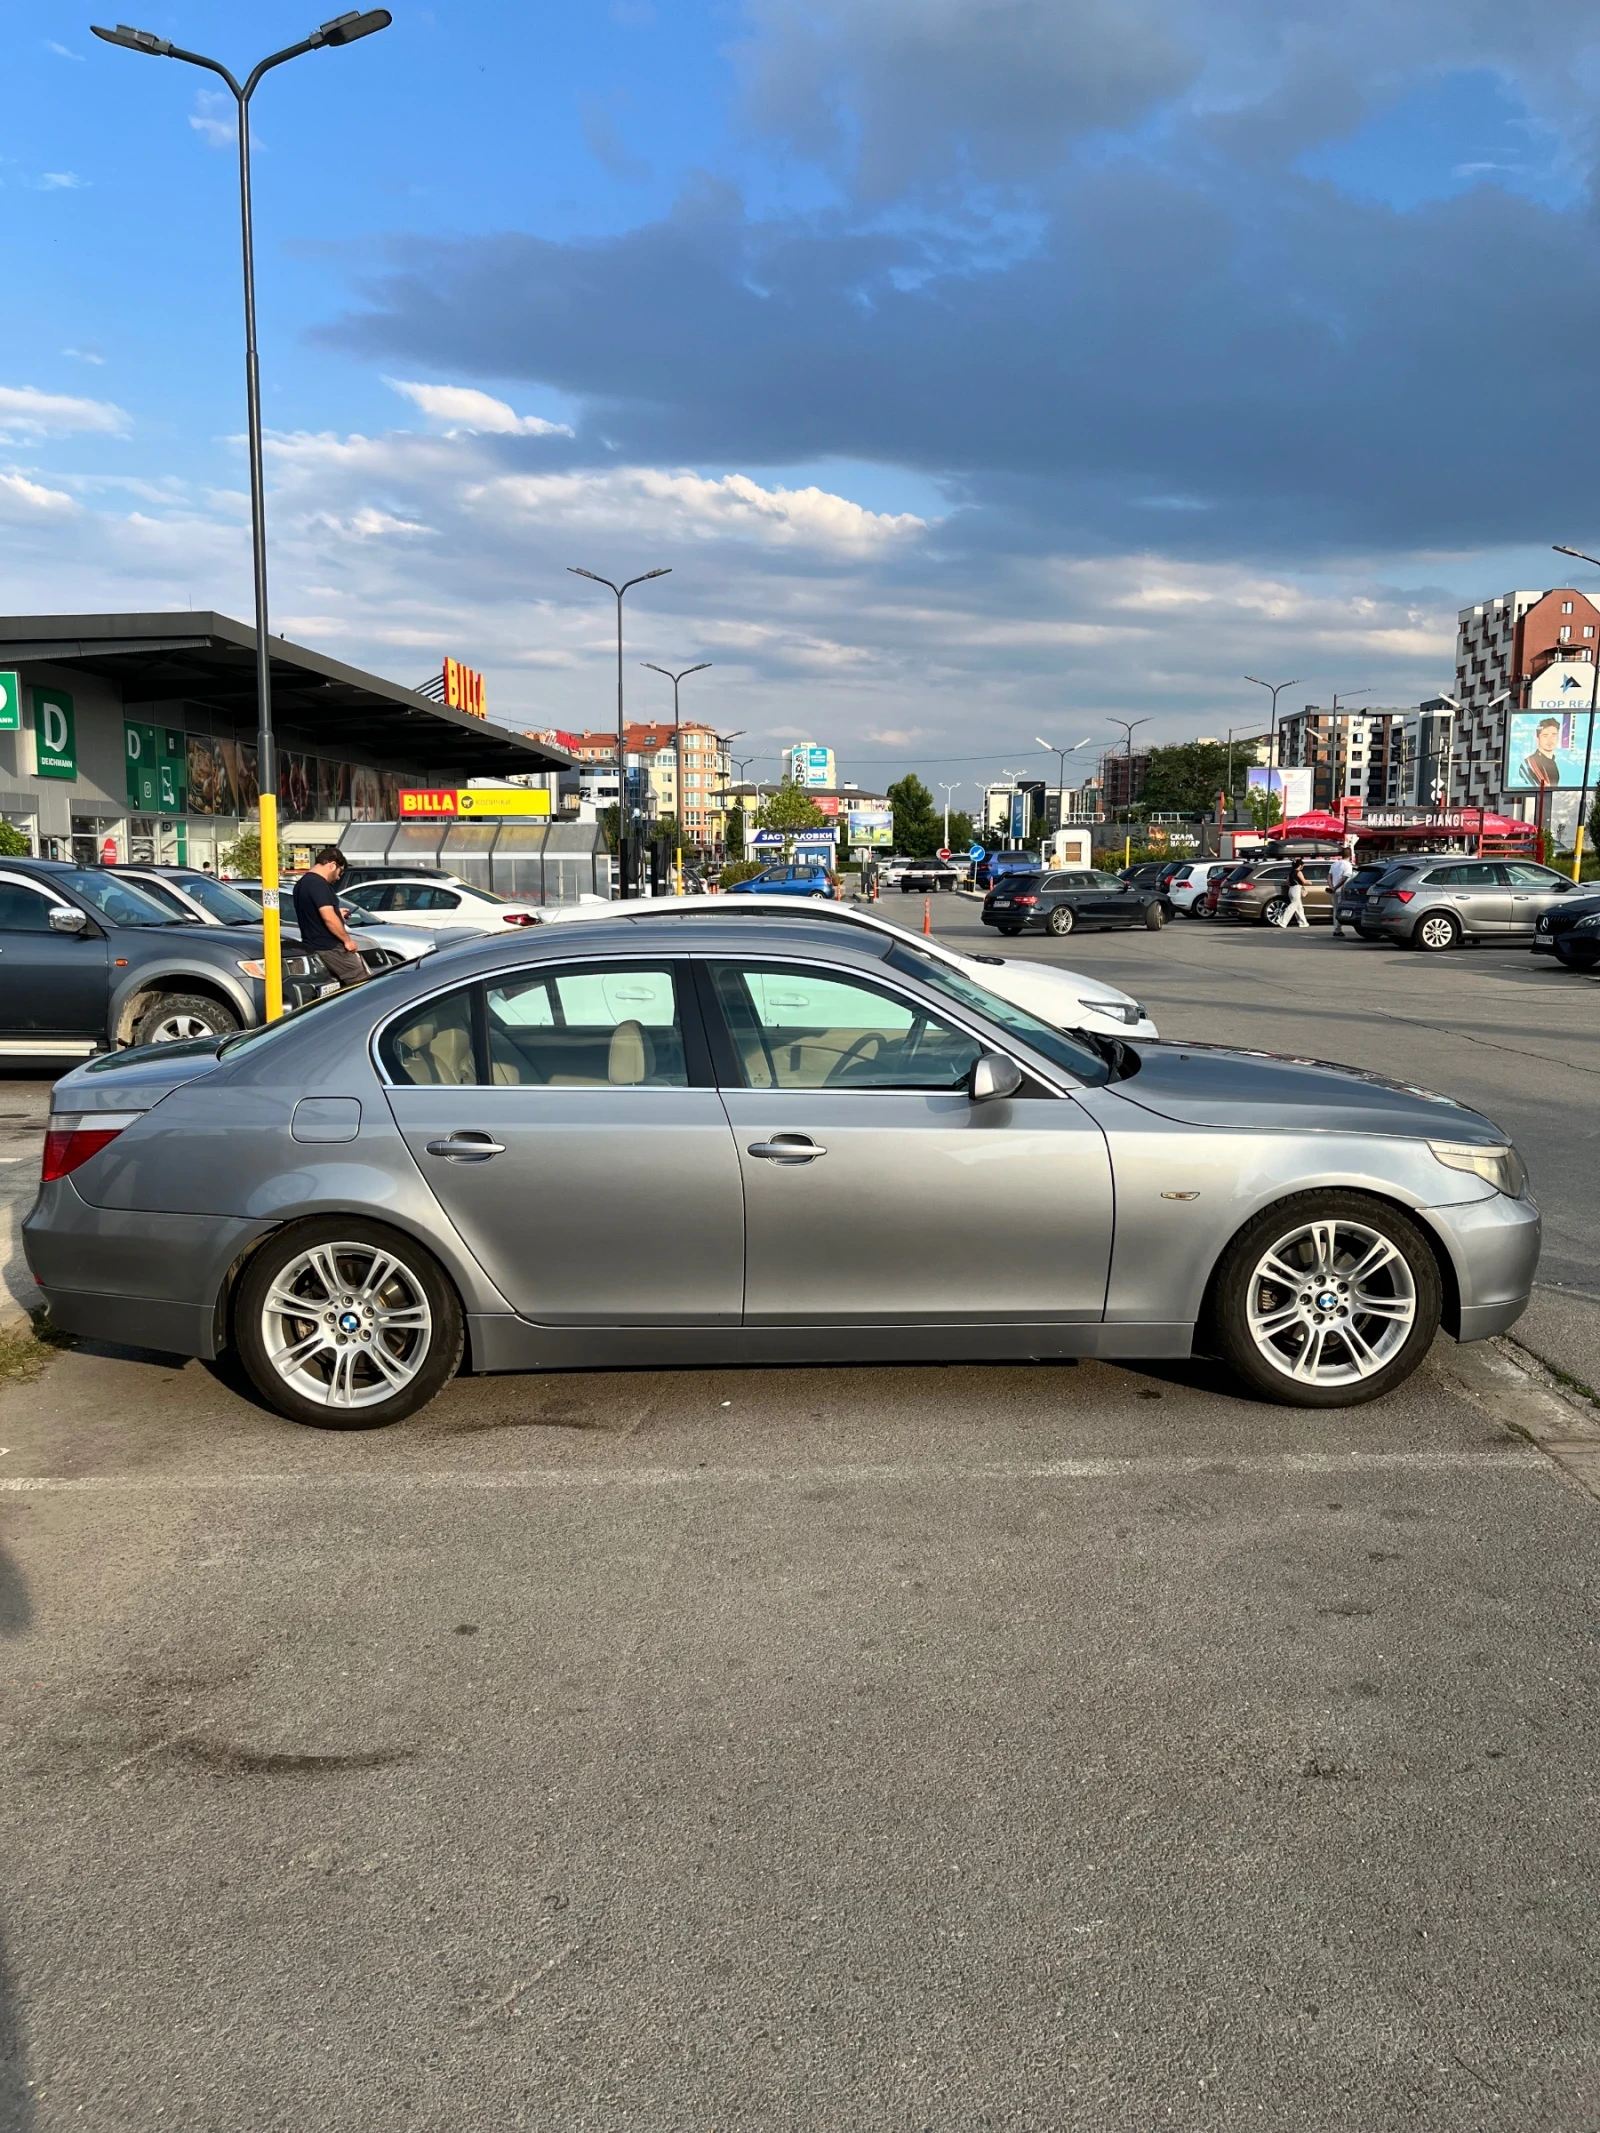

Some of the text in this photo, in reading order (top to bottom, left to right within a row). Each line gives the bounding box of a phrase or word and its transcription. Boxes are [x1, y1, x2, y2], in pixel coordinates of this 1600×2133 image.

[444, 656, 487, 720] BILLA
[1540, 700, 1565, 708] TOP
[44, 702, 68, 752] D
[127, 729, 141, 759] D
[41, 757, 73, 768] DEICHMANN
[403, 794, 455, 811] BILLA
[1367, 813, 1405, 827] MANGI
[1425, 813, 1464, 827] PIANGI
[1170, 833, 1195, 841] СКАРА
